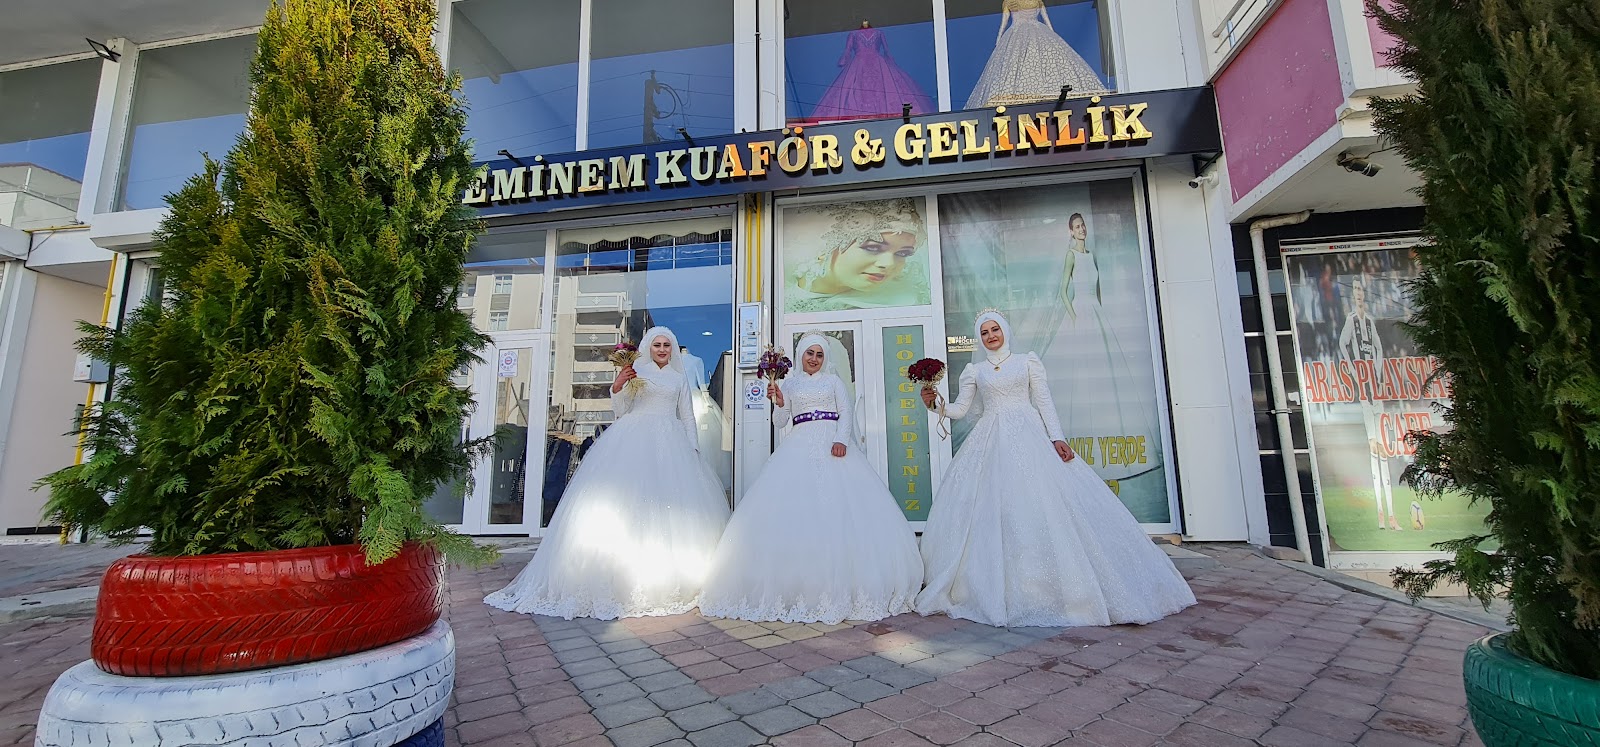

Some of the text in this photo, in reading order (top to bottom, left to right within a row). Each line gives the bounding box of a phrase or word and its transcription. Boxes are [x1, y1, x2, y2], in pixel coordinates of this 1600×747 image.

[462, 95, 1153, 204] EMİNEM KUAFÖR & GELİNLİK
[1304, 355, 1455, 403] ARAS PLAYSTA
[1098, 436, 1147, 469] YERDE
